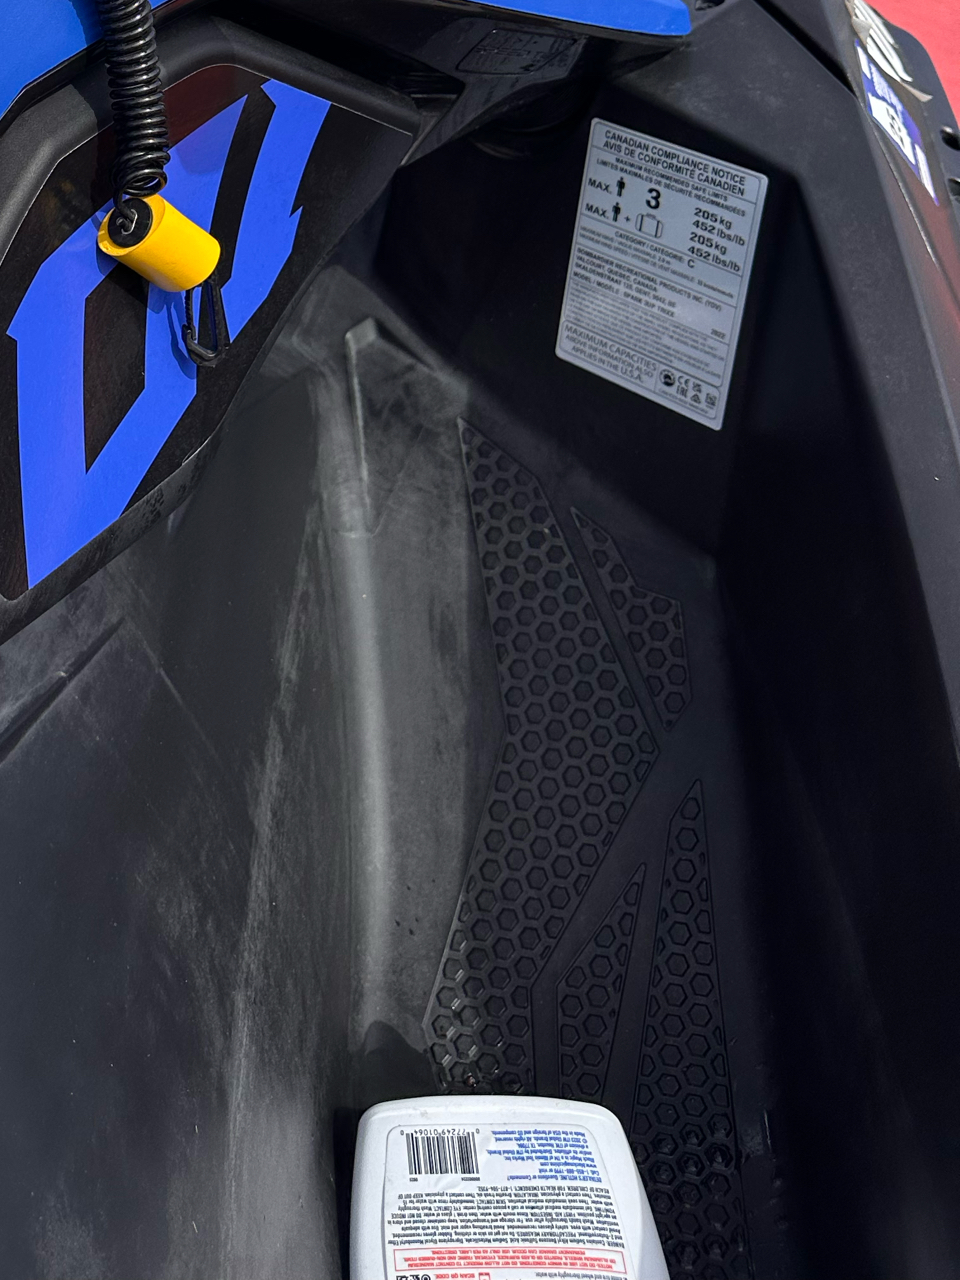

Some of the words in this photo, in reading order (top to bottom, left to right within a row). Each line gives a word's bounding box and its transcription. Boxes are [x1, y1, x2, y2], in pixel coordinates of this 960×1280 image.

[602, 139, 621, 154] AVIS
[624, 146, 635, 158] DE
[637, 151, 694, 180] CONFORMITÉ
[697, 171, 744, 197] CANADIEN
[604, 129, 649, 153] CANADIAN
[650, 144, 708, 173] COMPLIANCE
[711, 165, 745, 187] NOTICE
[588, 177, 612, 194] MAX.
[645, 188, 660, 210] 3
[584, 201, 608, 219] MAX.
[693, 206, 717, 223] 205
[719, 215, 732, 230] kg
[689, 230, 713, 248] 205
[714, 239, 726, 256] kg
[692, 217, 715, 235] 452
[717, 227, 745, 246] lbs/lb
[687, 243, 710, 261] 452
[711, 253, 740, 273] lbs/lb
[564, 322, 607, 349] MAXIMUM
[609, 341, 656, 372] CAPACITIES
